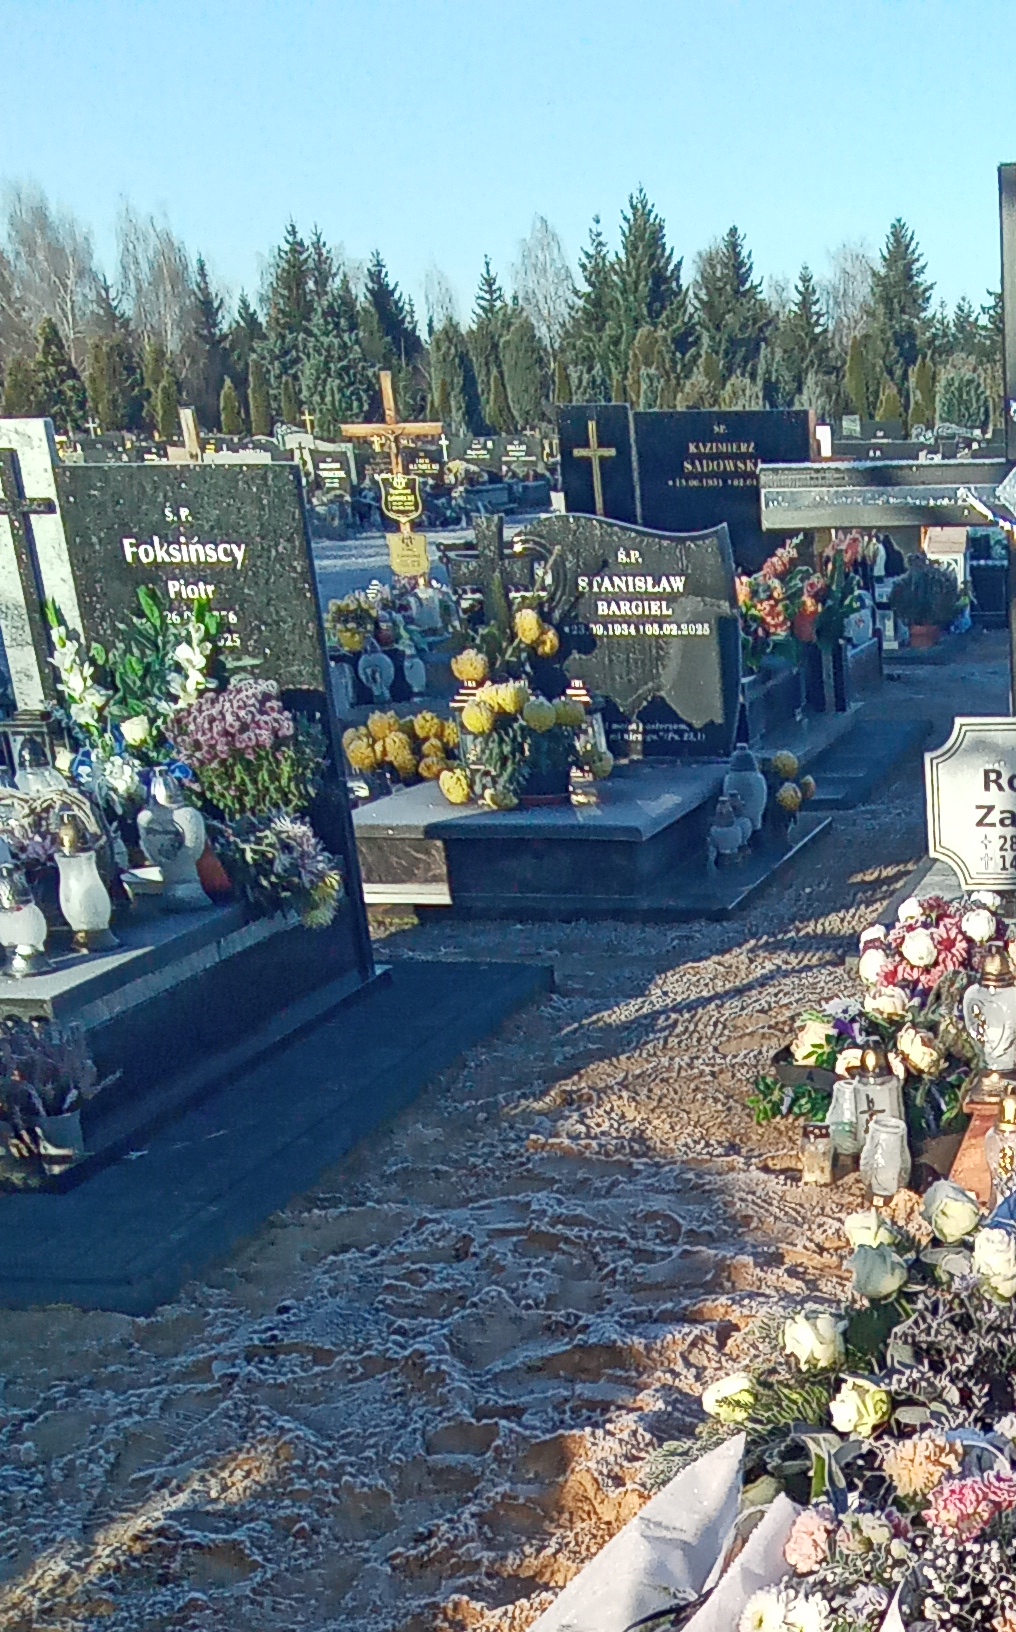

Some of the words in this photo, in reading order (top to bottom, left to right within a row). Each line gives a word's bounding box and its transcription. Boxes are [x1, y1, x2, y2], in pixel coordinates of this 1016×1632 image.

[688, 442, 756, 453] KAZIMIERZ
[122, 535, 246, 570] Foksińscy
[167, 579, 216, 600] Piotr
[577, 576, 686, 593] STANISŁAW
[597, 600, 673, 616] BARGIEL
